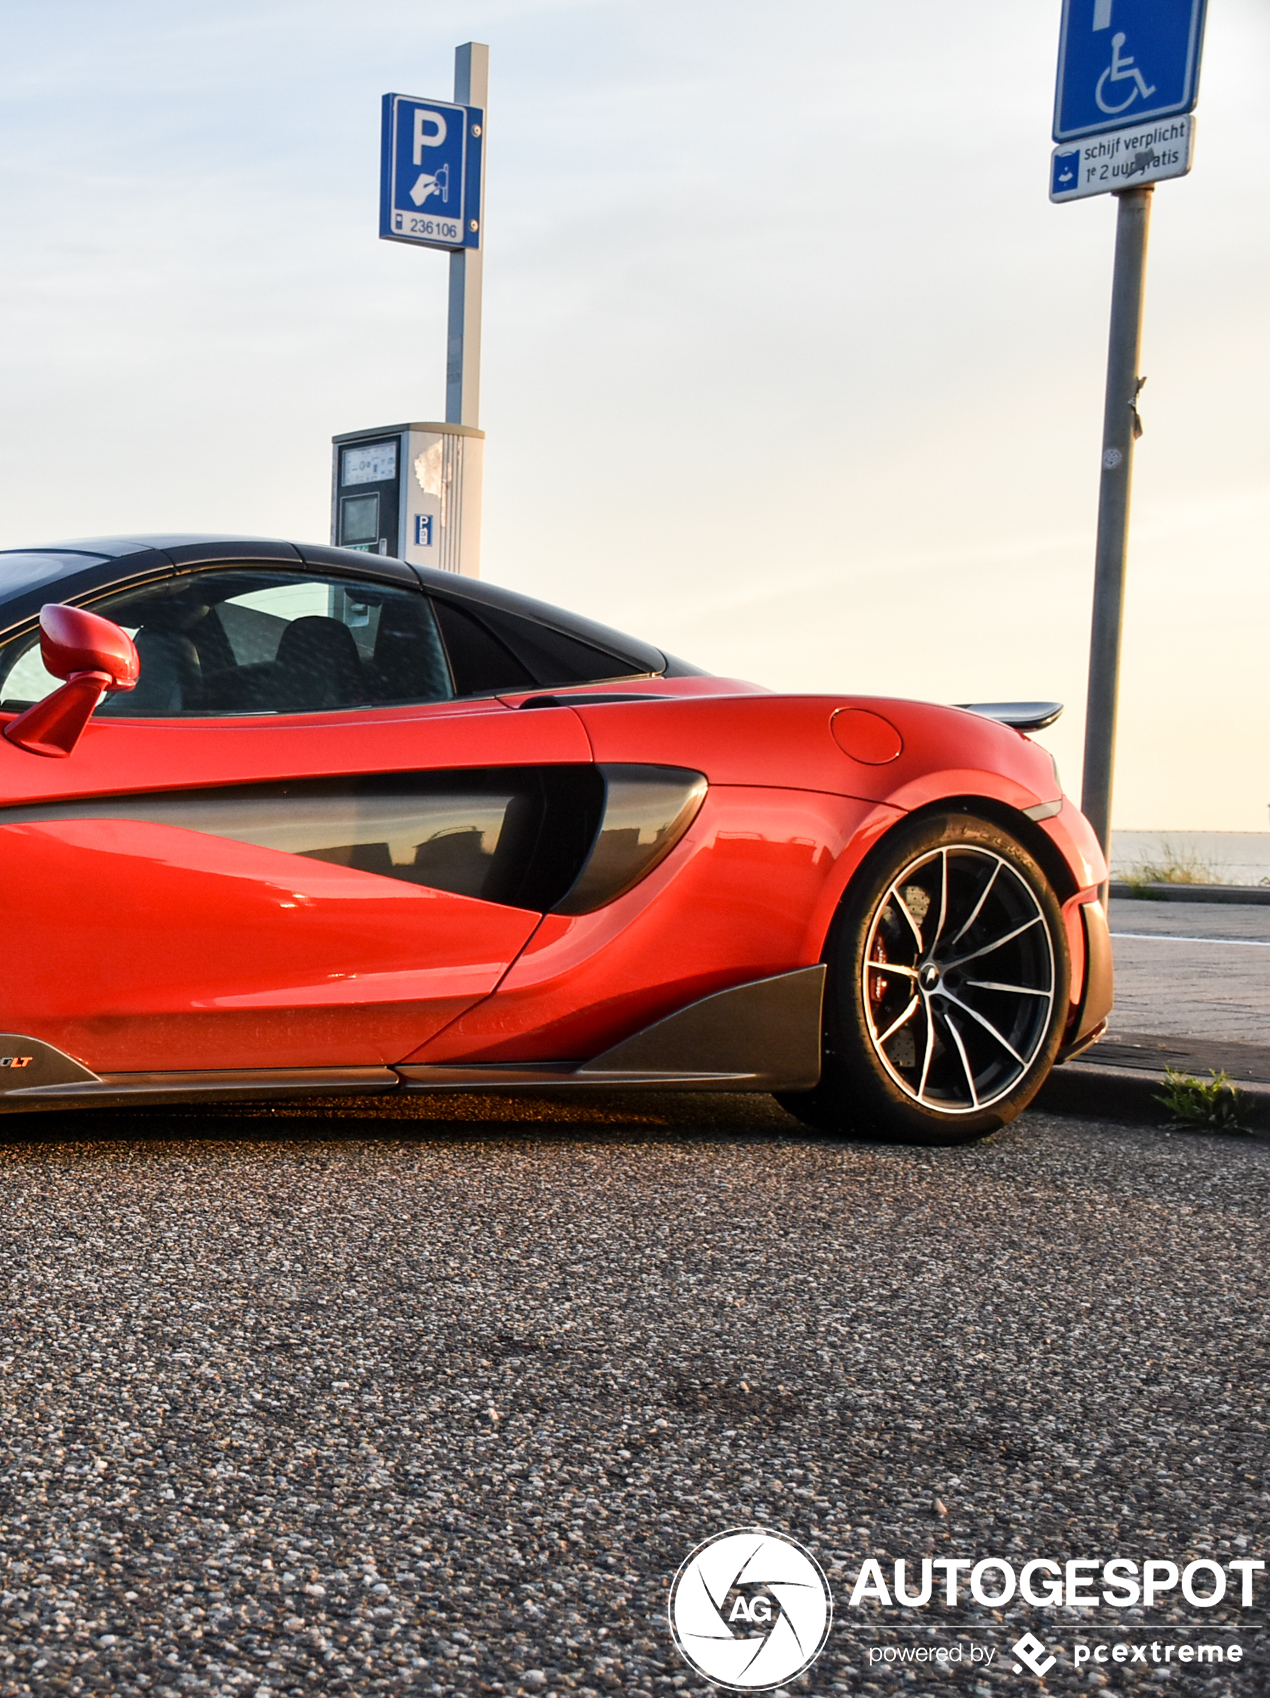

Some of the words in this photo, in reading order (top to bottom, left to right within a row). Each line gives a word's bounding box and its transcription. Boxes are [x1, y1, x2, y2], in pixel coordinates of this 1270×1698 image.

[413, 108, 447, 166] P
[1084, 137, 1121, 160] schijf
[1124, 122, 1185, 150] verplicht
[1099, 164, 1109, 180] 2
[410, 218, 457, 239] 236106
[419, 516, 429, 528] P
